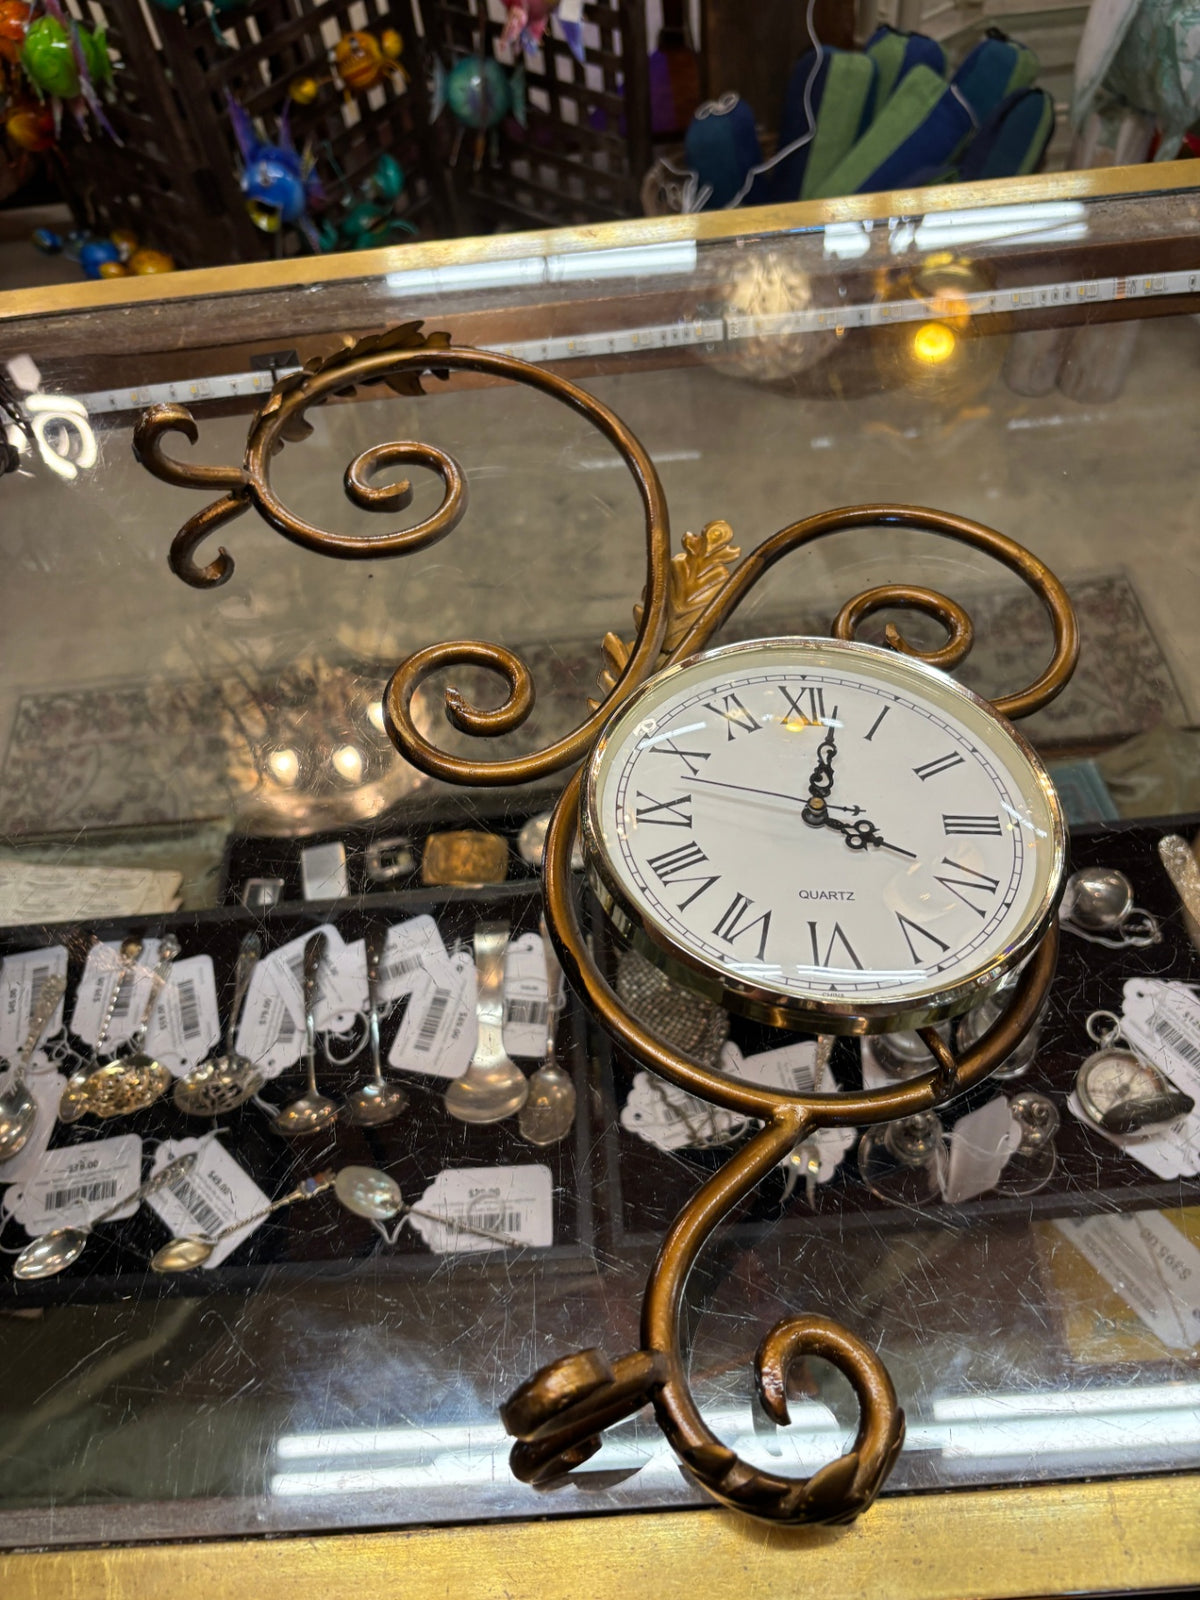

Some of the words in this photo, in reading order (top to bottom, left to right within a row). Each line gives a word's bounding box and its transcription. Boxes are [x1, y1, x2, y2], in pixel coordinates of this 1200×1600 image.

[703, 693, 763, 741] XI
[778, 685, 826, 727] XII
[864, 704, 890, 741] I
[649, 738, 711, 776] X
[912, 751, 966, 782] II
[636, 790, 693, 829] IX
[941, 814, 1003, 836] III
[645, 840, 722, 913] VIII
[798, 889, 856, 901] QUARTZ
[933, 857, 1001, 919] IV
[711, 892, 773, 962] VII
[807, 920, 864, 969] VI
[895, 911, 950, 965] V
